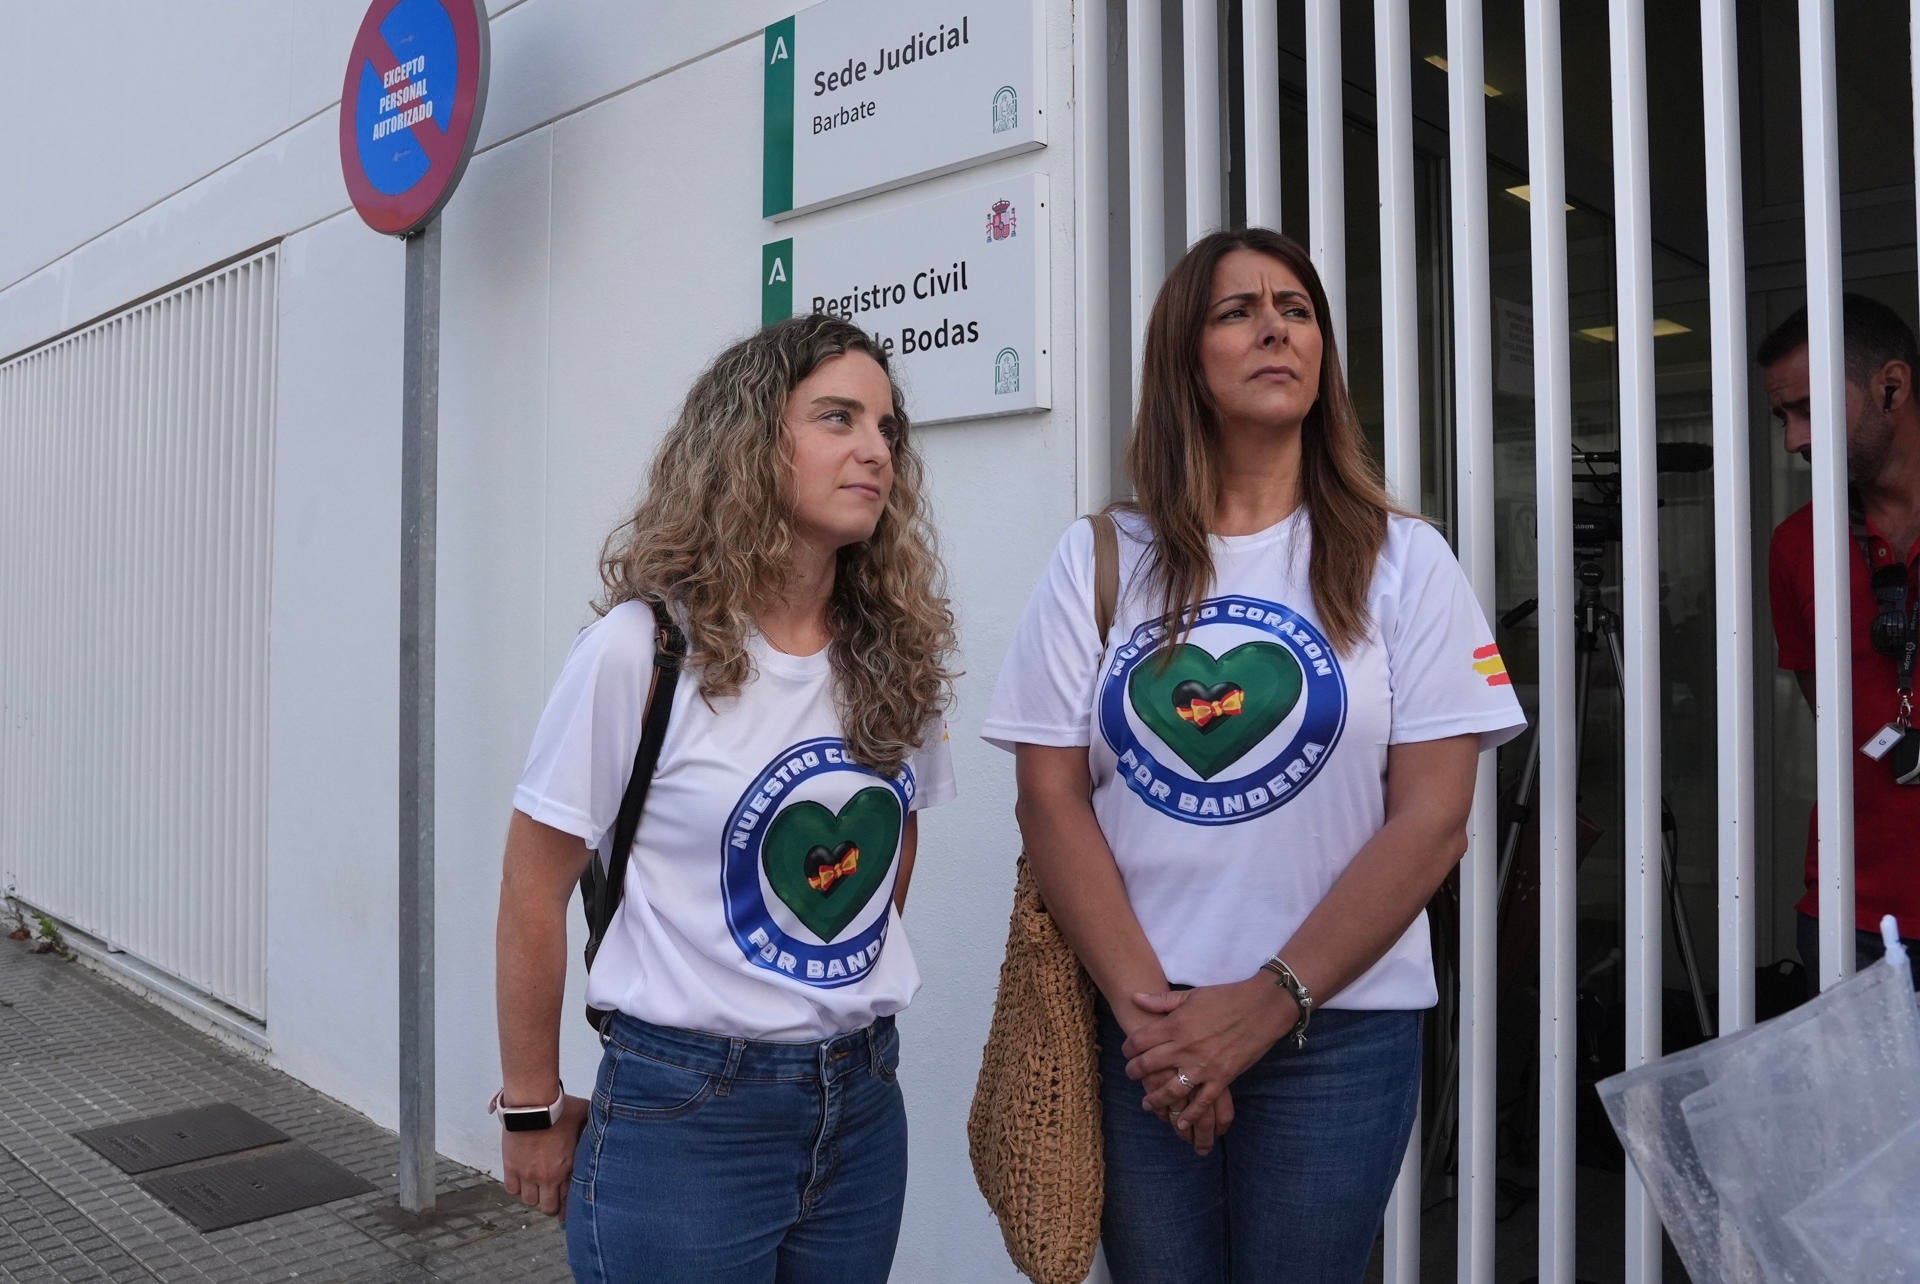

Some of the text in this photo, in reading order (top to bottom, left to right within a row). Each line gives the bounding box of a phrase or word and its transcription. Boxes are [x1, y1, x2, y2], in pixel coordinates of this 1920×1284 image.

[384, 55, 425, 89] EXCEPTO
[813, 16, 969, 97] Sede Judicial
[379, 78, 428, 114] PERSONAL
[812, 100, 876, 135] Barbate
[372, 100, 433, 141] AUTORIZADO
[812, 261, 968, 322] Registro Civil
[902, 318, 980, 355] Bodas
[1227, 603, 1332, 677] CORAZON
[730, 751, 820, 850] NUESTRO
[1119, 741, 1326, 816] POR BANDERA
[748, 927, 797, 975] POR
